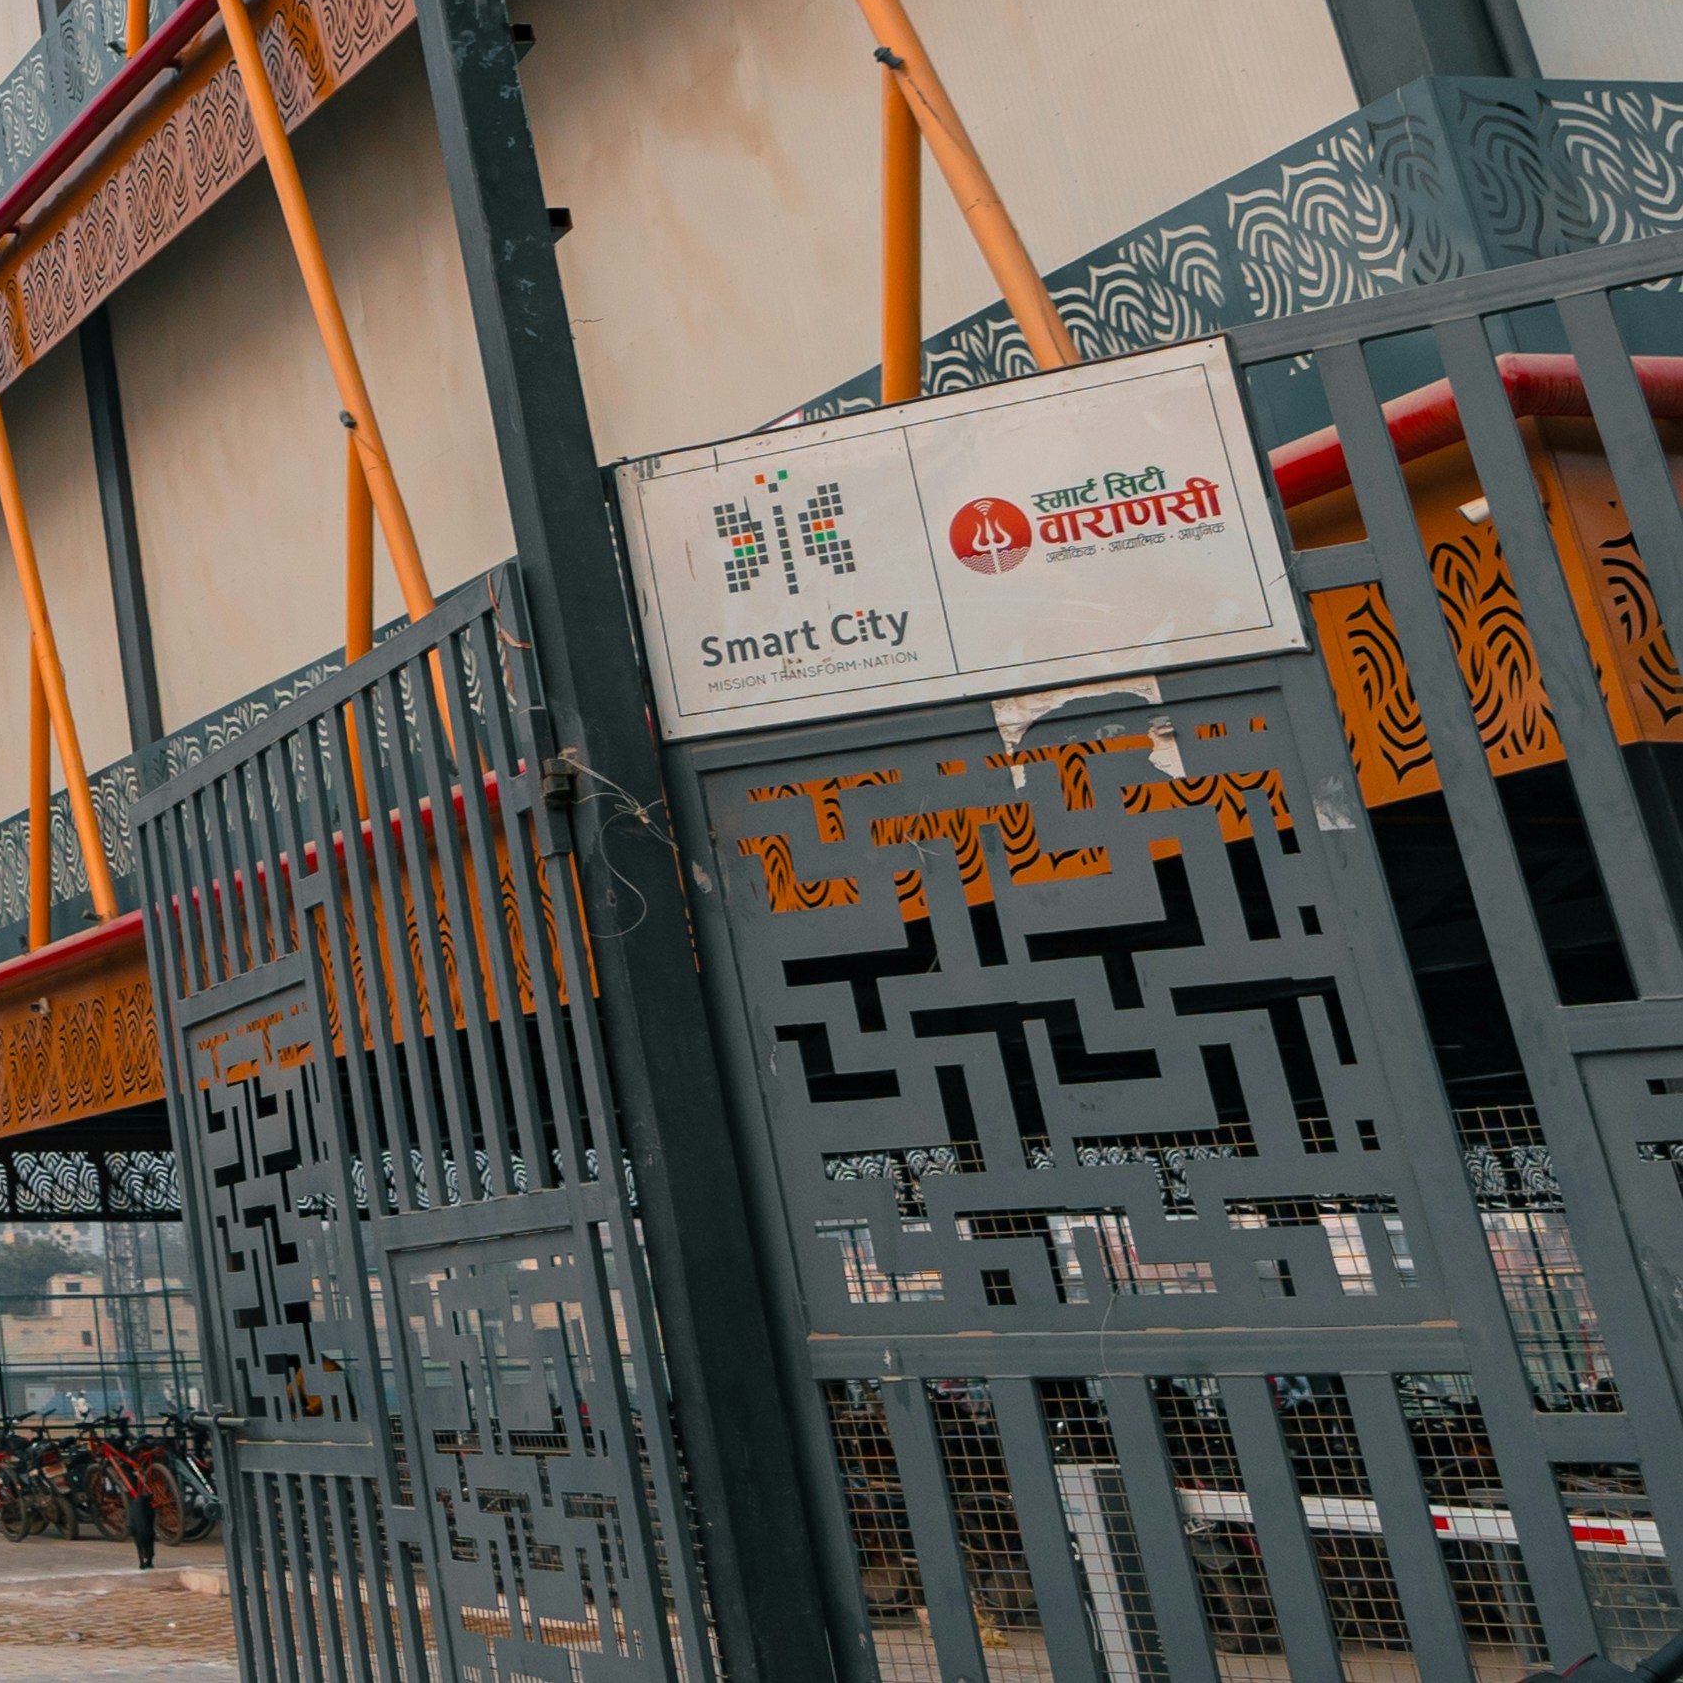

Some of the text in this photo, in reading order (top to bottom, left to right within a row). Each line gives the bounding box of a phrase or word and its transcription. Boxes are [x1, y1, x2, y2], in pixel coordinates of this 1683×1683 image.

[1030, 465, 1167, 514] स्मार्ट सिटी
[1036, 476, 1222, 544] वाराणसी
[700, 608, 909, 668] Smart City
[707, 650, 919, 694] MISSION TRANSFORM-NATION
